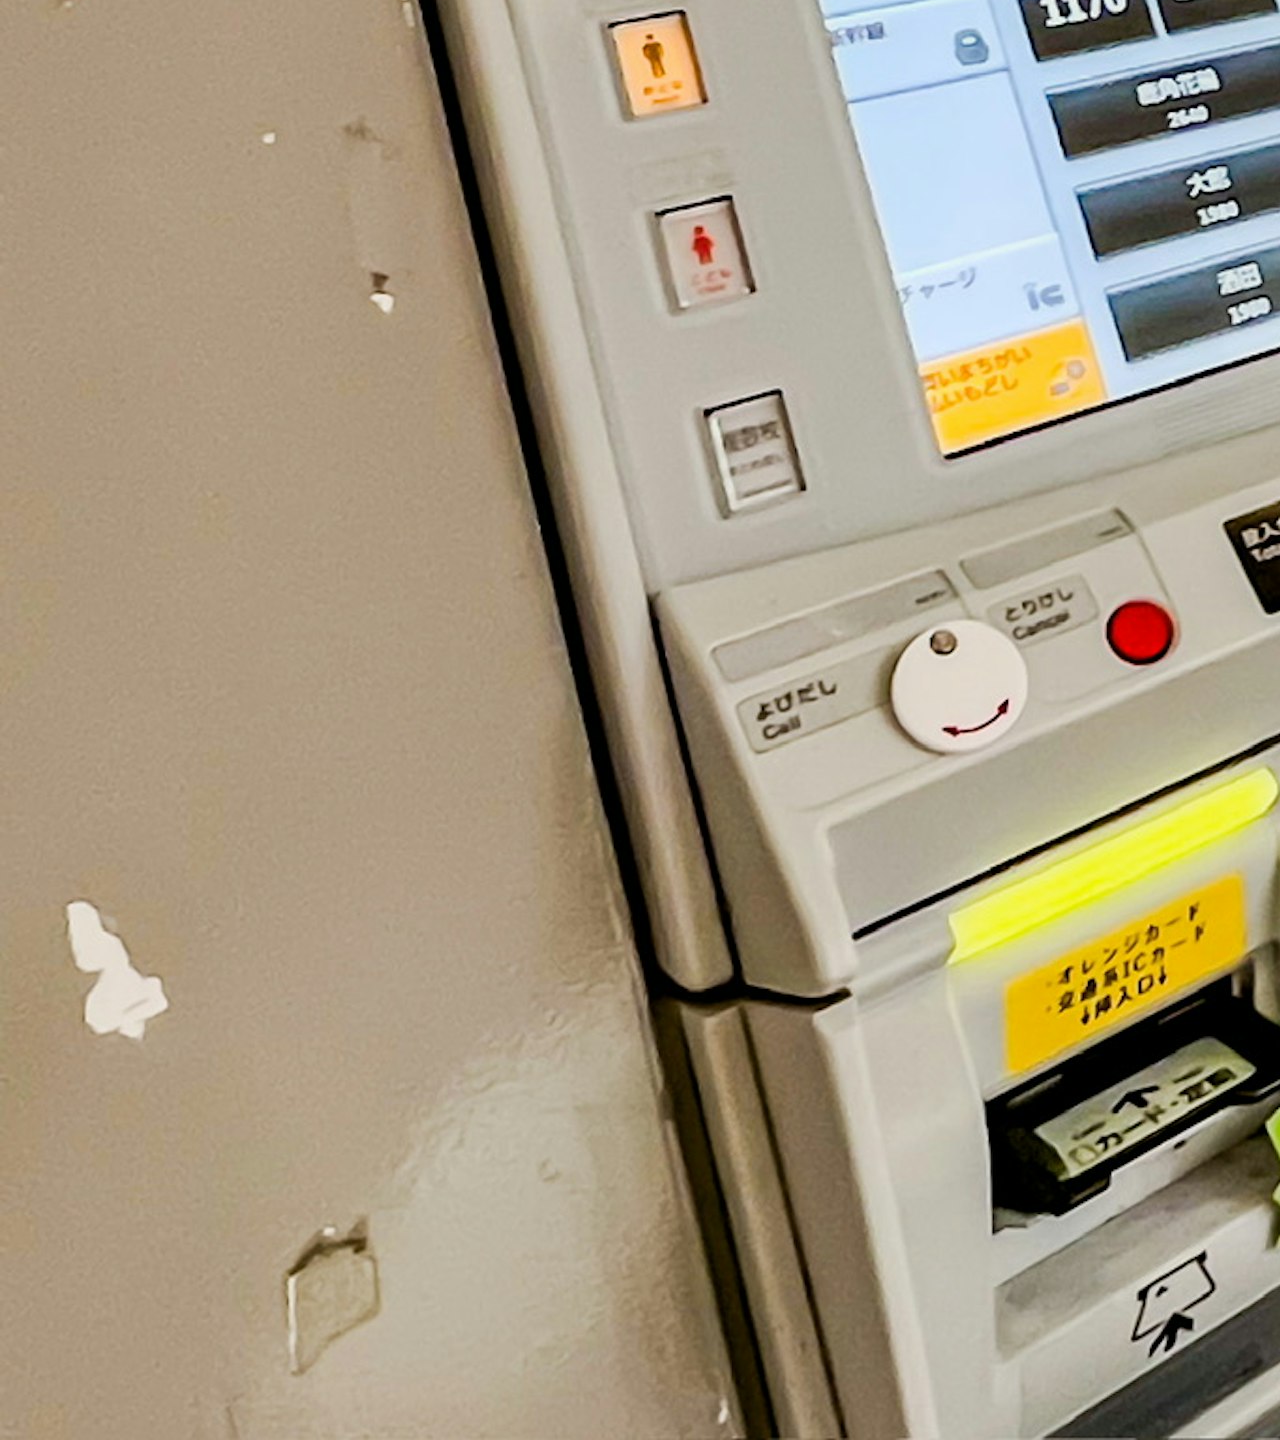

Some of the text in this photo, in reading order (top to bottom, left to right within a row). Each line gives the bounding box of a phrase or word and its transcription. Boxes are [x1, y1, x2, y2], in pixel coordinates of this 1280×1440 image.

[755, 677, 839, 722] よびだし
[762, 715, 803, 741] Call
